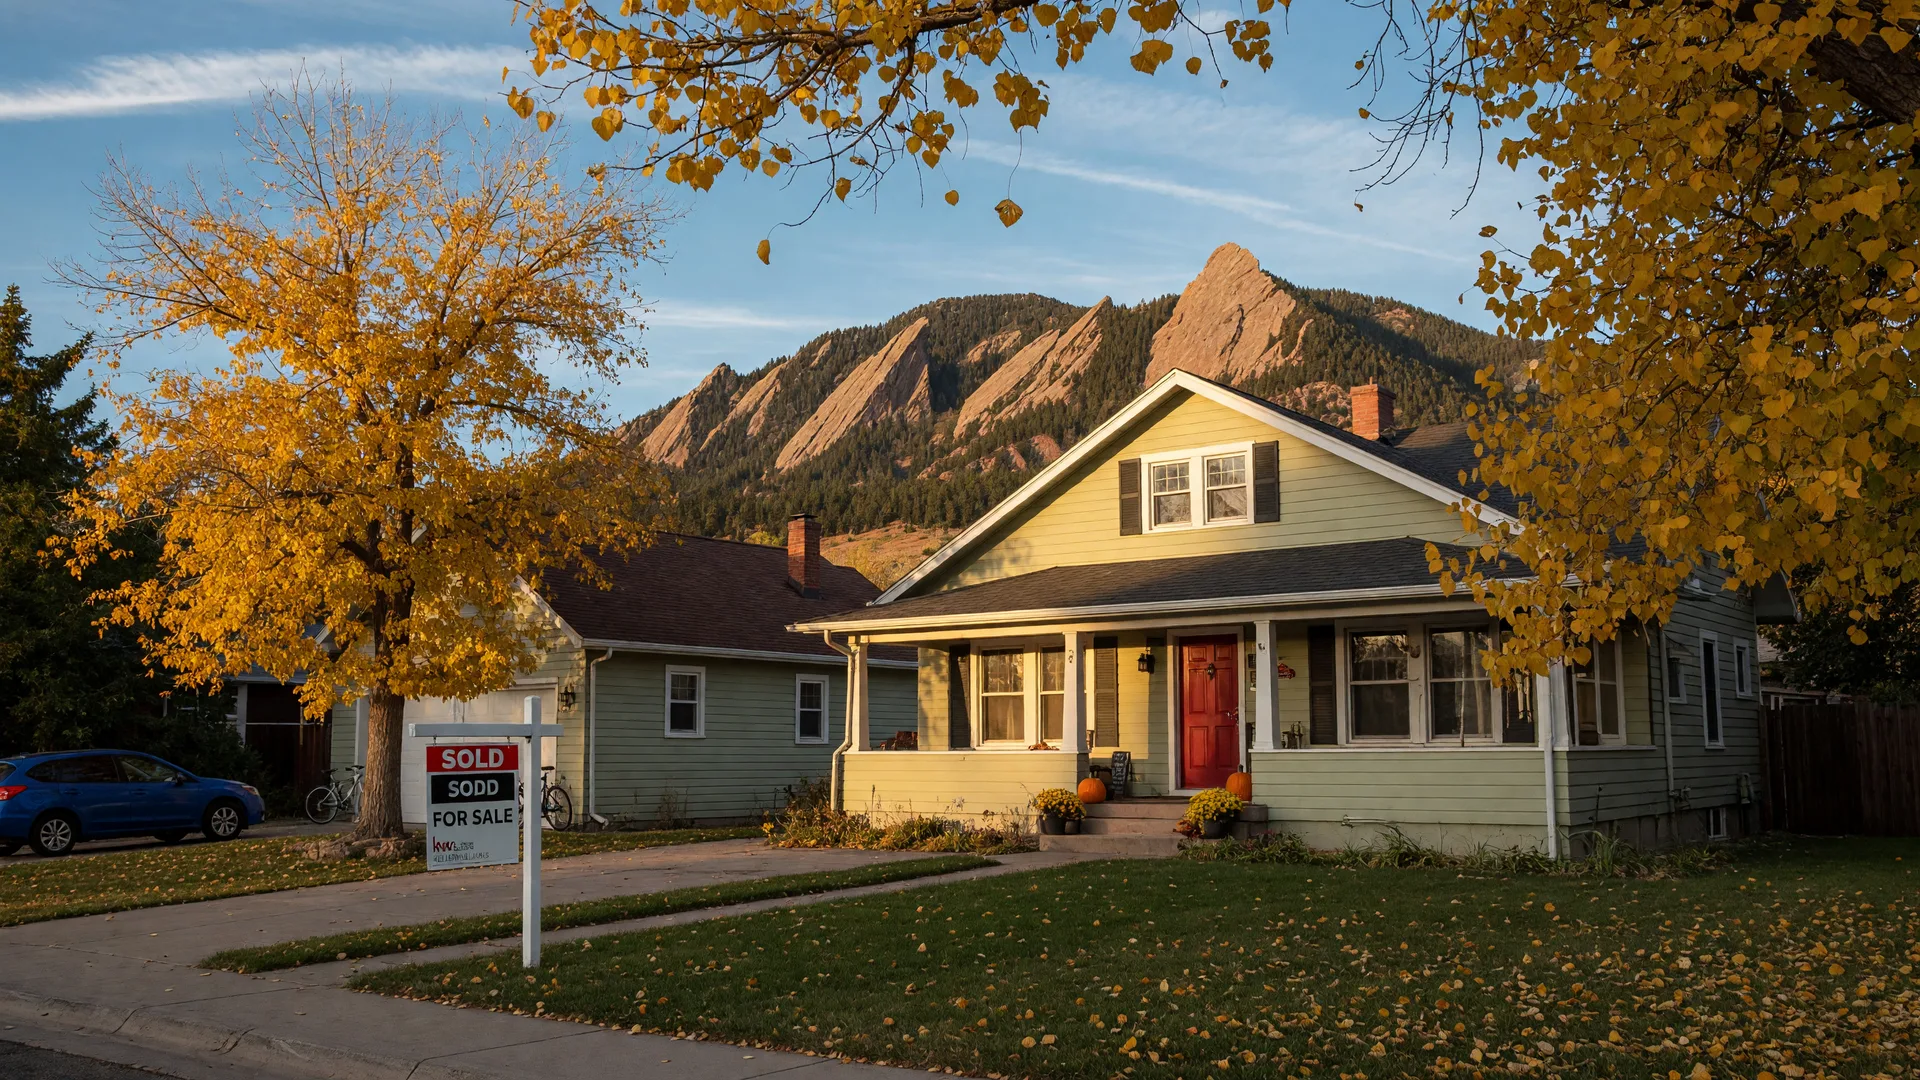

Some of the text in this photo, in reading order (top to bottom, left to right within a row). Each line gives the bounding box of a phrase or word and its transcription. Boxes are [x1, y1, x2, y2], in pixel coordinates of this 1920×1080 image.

[442, 748, 504, 769] SOLD
[448, 779, 499, 797] SODD
[433, 808, 513, 827] FOR SALE
